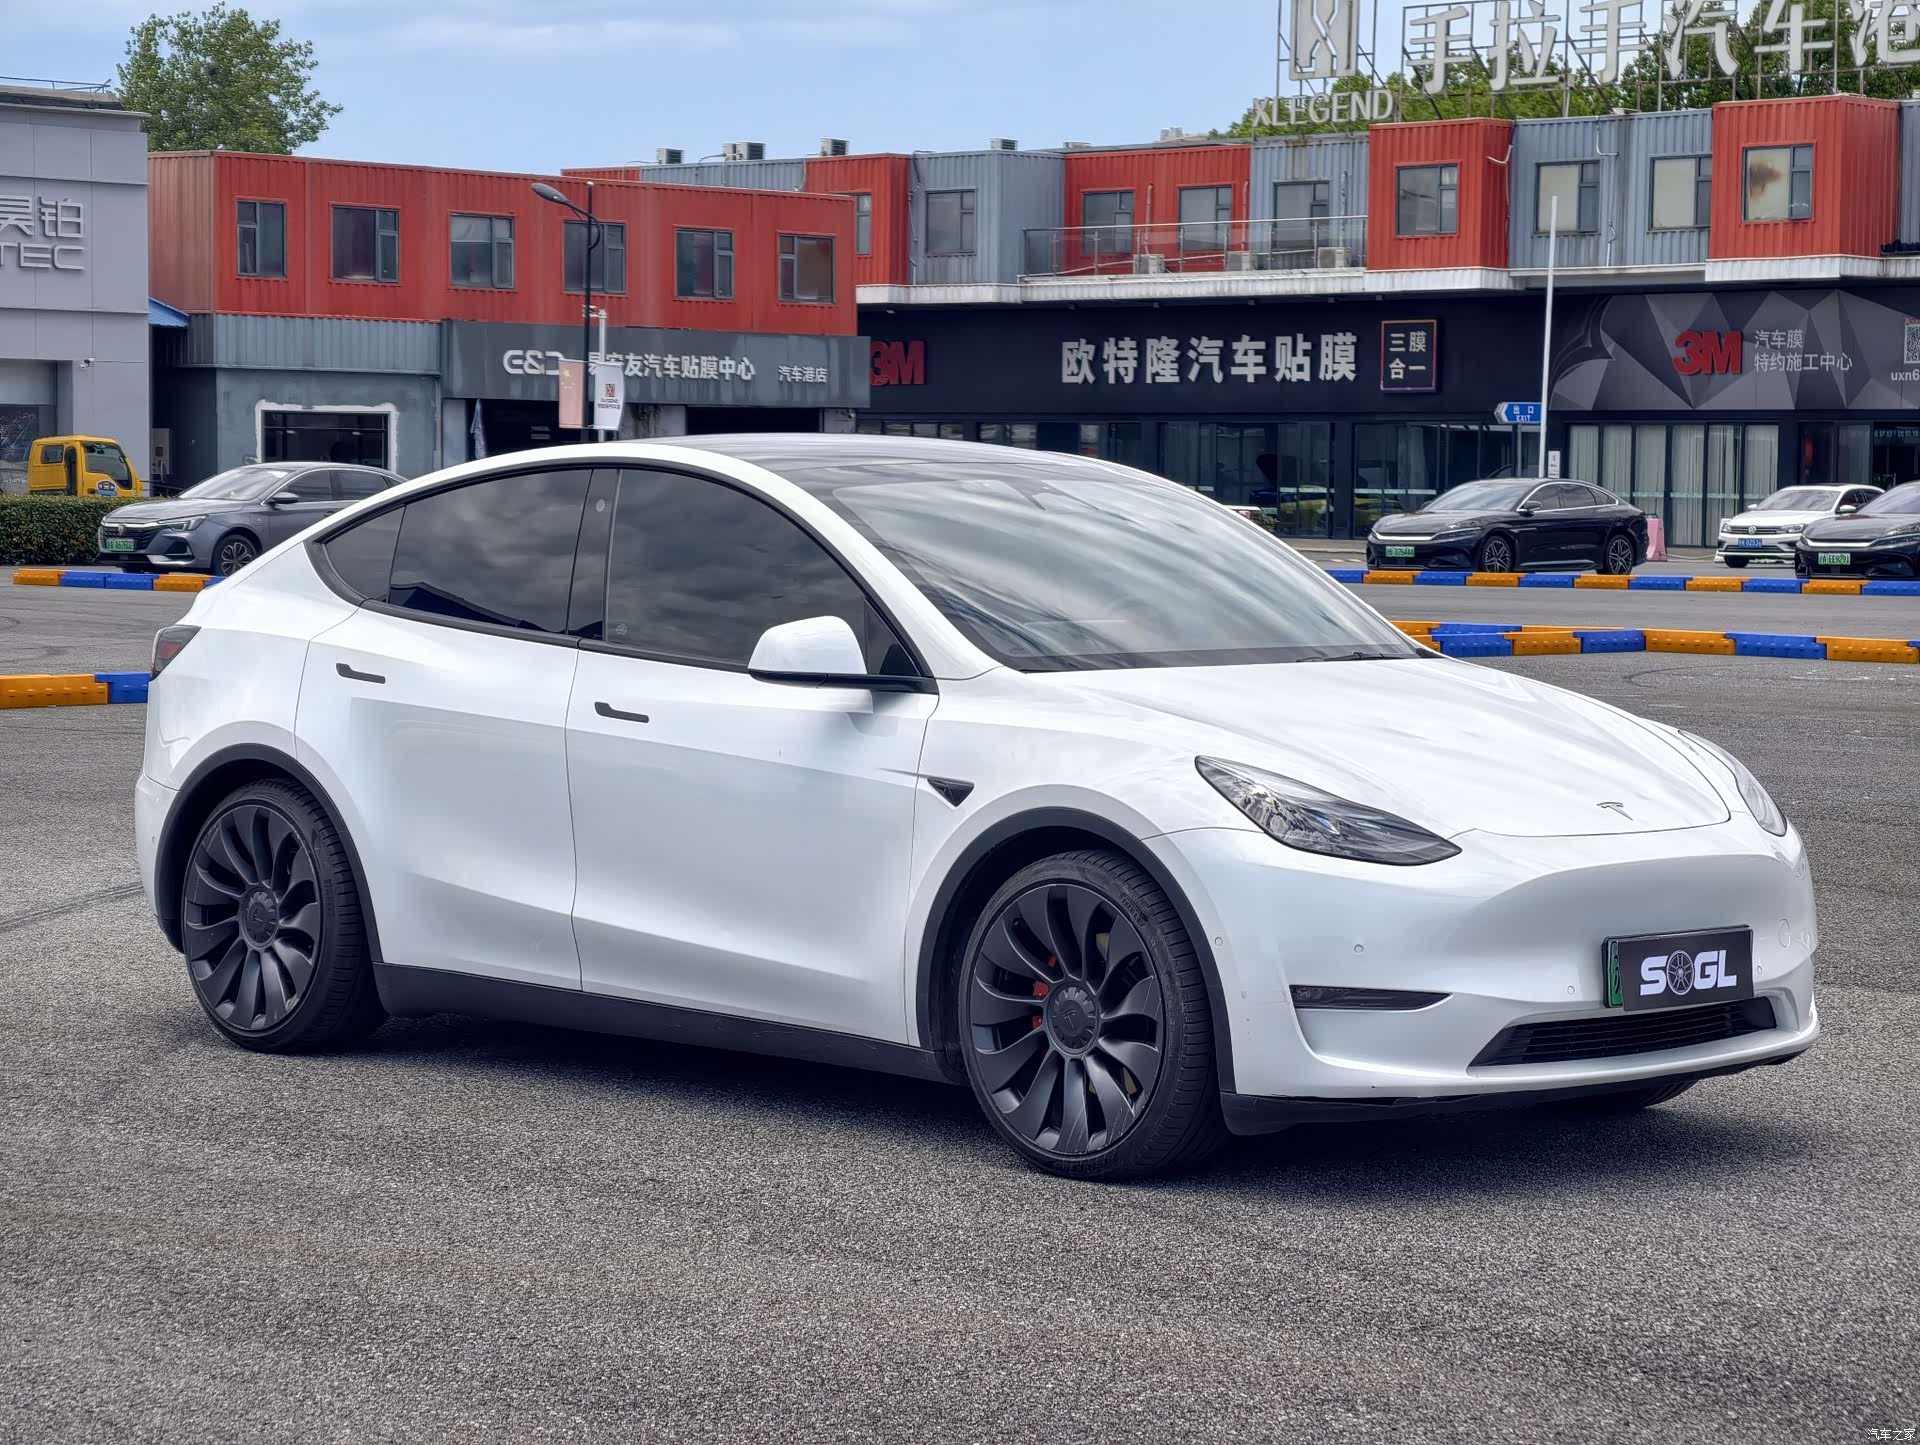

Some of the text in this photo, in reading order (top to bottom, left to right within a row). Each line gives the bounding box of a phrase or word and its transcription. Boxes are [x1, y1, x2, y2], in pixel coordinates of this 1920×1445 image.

[1252, 89, 1394, 127] XLEGEND
[1389, 331, 1427, 352] 三膜
[1755, 329, 1804, 349] 汽车膜
[868, 340, 925, 386] 3M
[1061, 332, 1358, 384] 欧特隆汽车贴膜
[1672, 330, 1743, 375] 3M
[1754, 351, 1853, 373] 特约施工中心
[778, 366, 828, 384] 汽车港店
[1389, 358, 1426, 379] 合一
